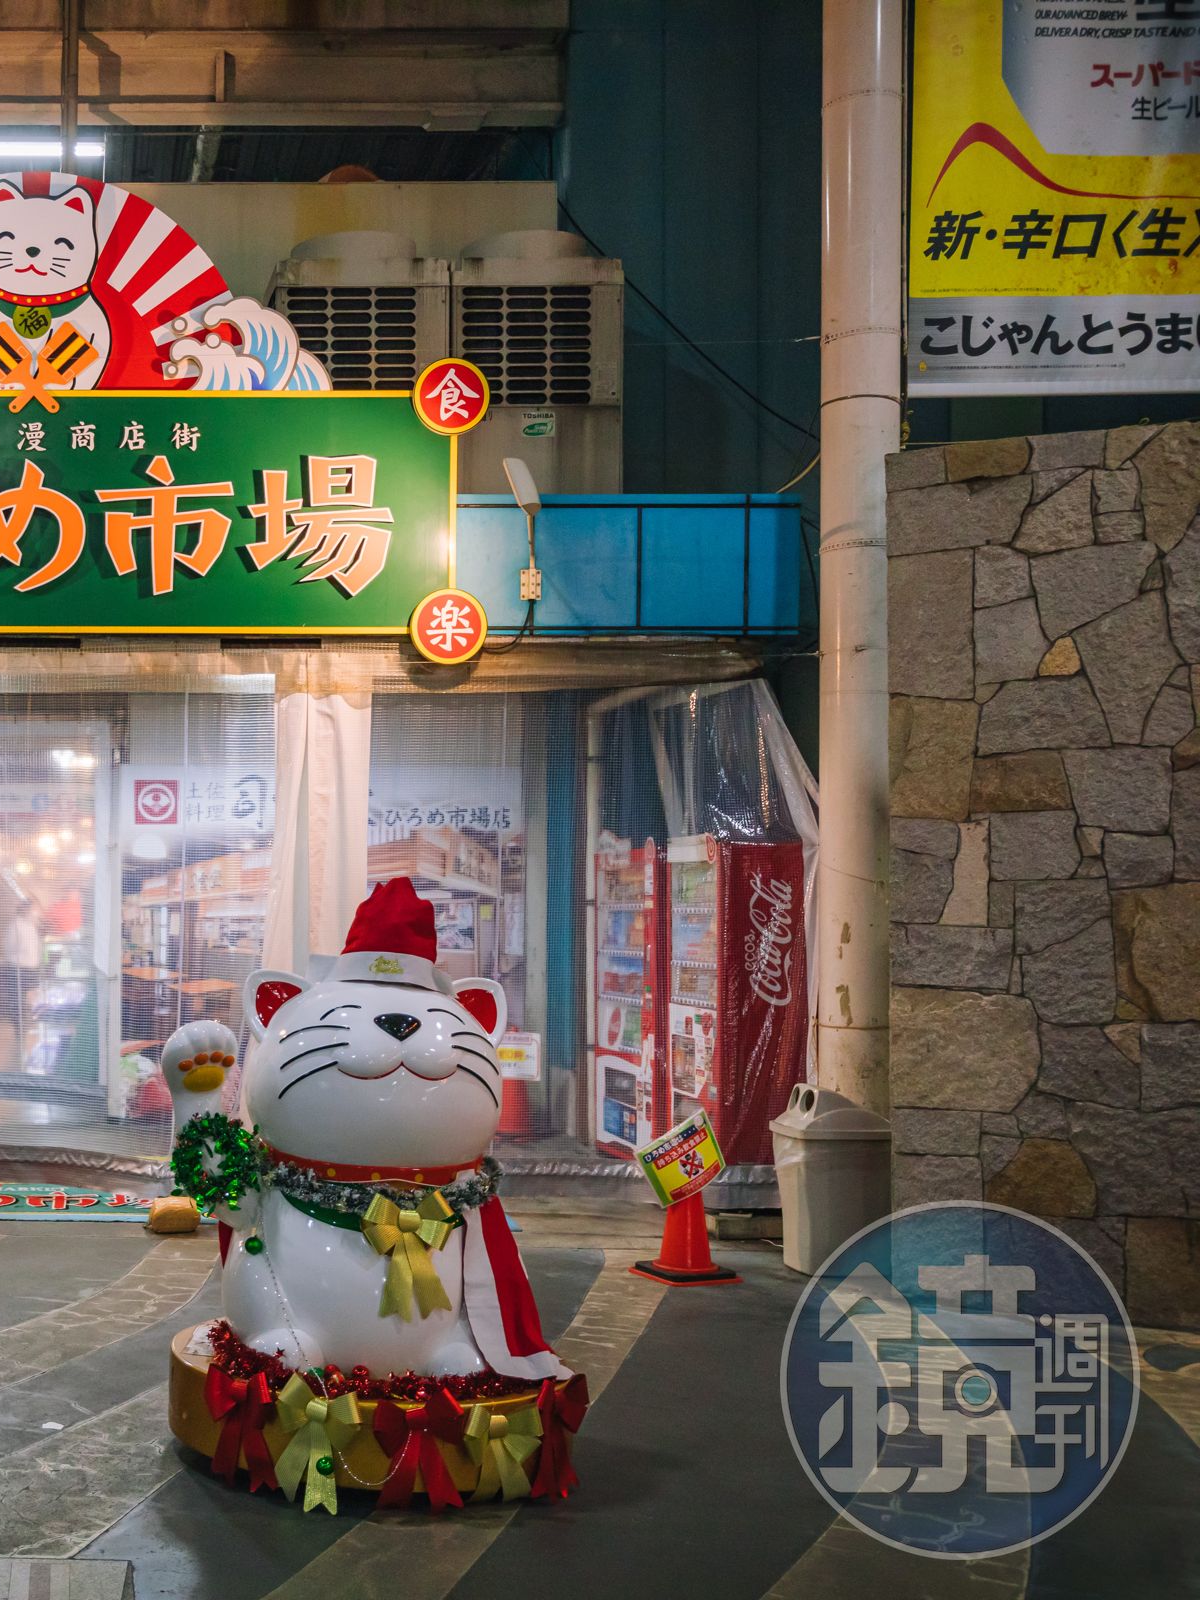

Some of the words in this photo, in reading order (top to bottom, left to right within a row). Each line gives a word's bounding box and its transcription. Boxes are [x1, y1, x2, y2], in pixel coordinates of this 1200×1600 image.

[1035, 27, 1070, 37] DELIVER
[1070, 27, 1079, 36] A
[1079, 27, 1100, 39] DRY,
[1101, 28, 1131, 38] CRISP
[1134, 27, 1167, 38] TASTE
[1170, 27, 1196, 37] AND
[19, 306, 49, 335] 福
[920, 311, 1200, 357] こじゃんとうま
[424, 368, 480, 422] 食
[424, 600, 476, 650] 楽
